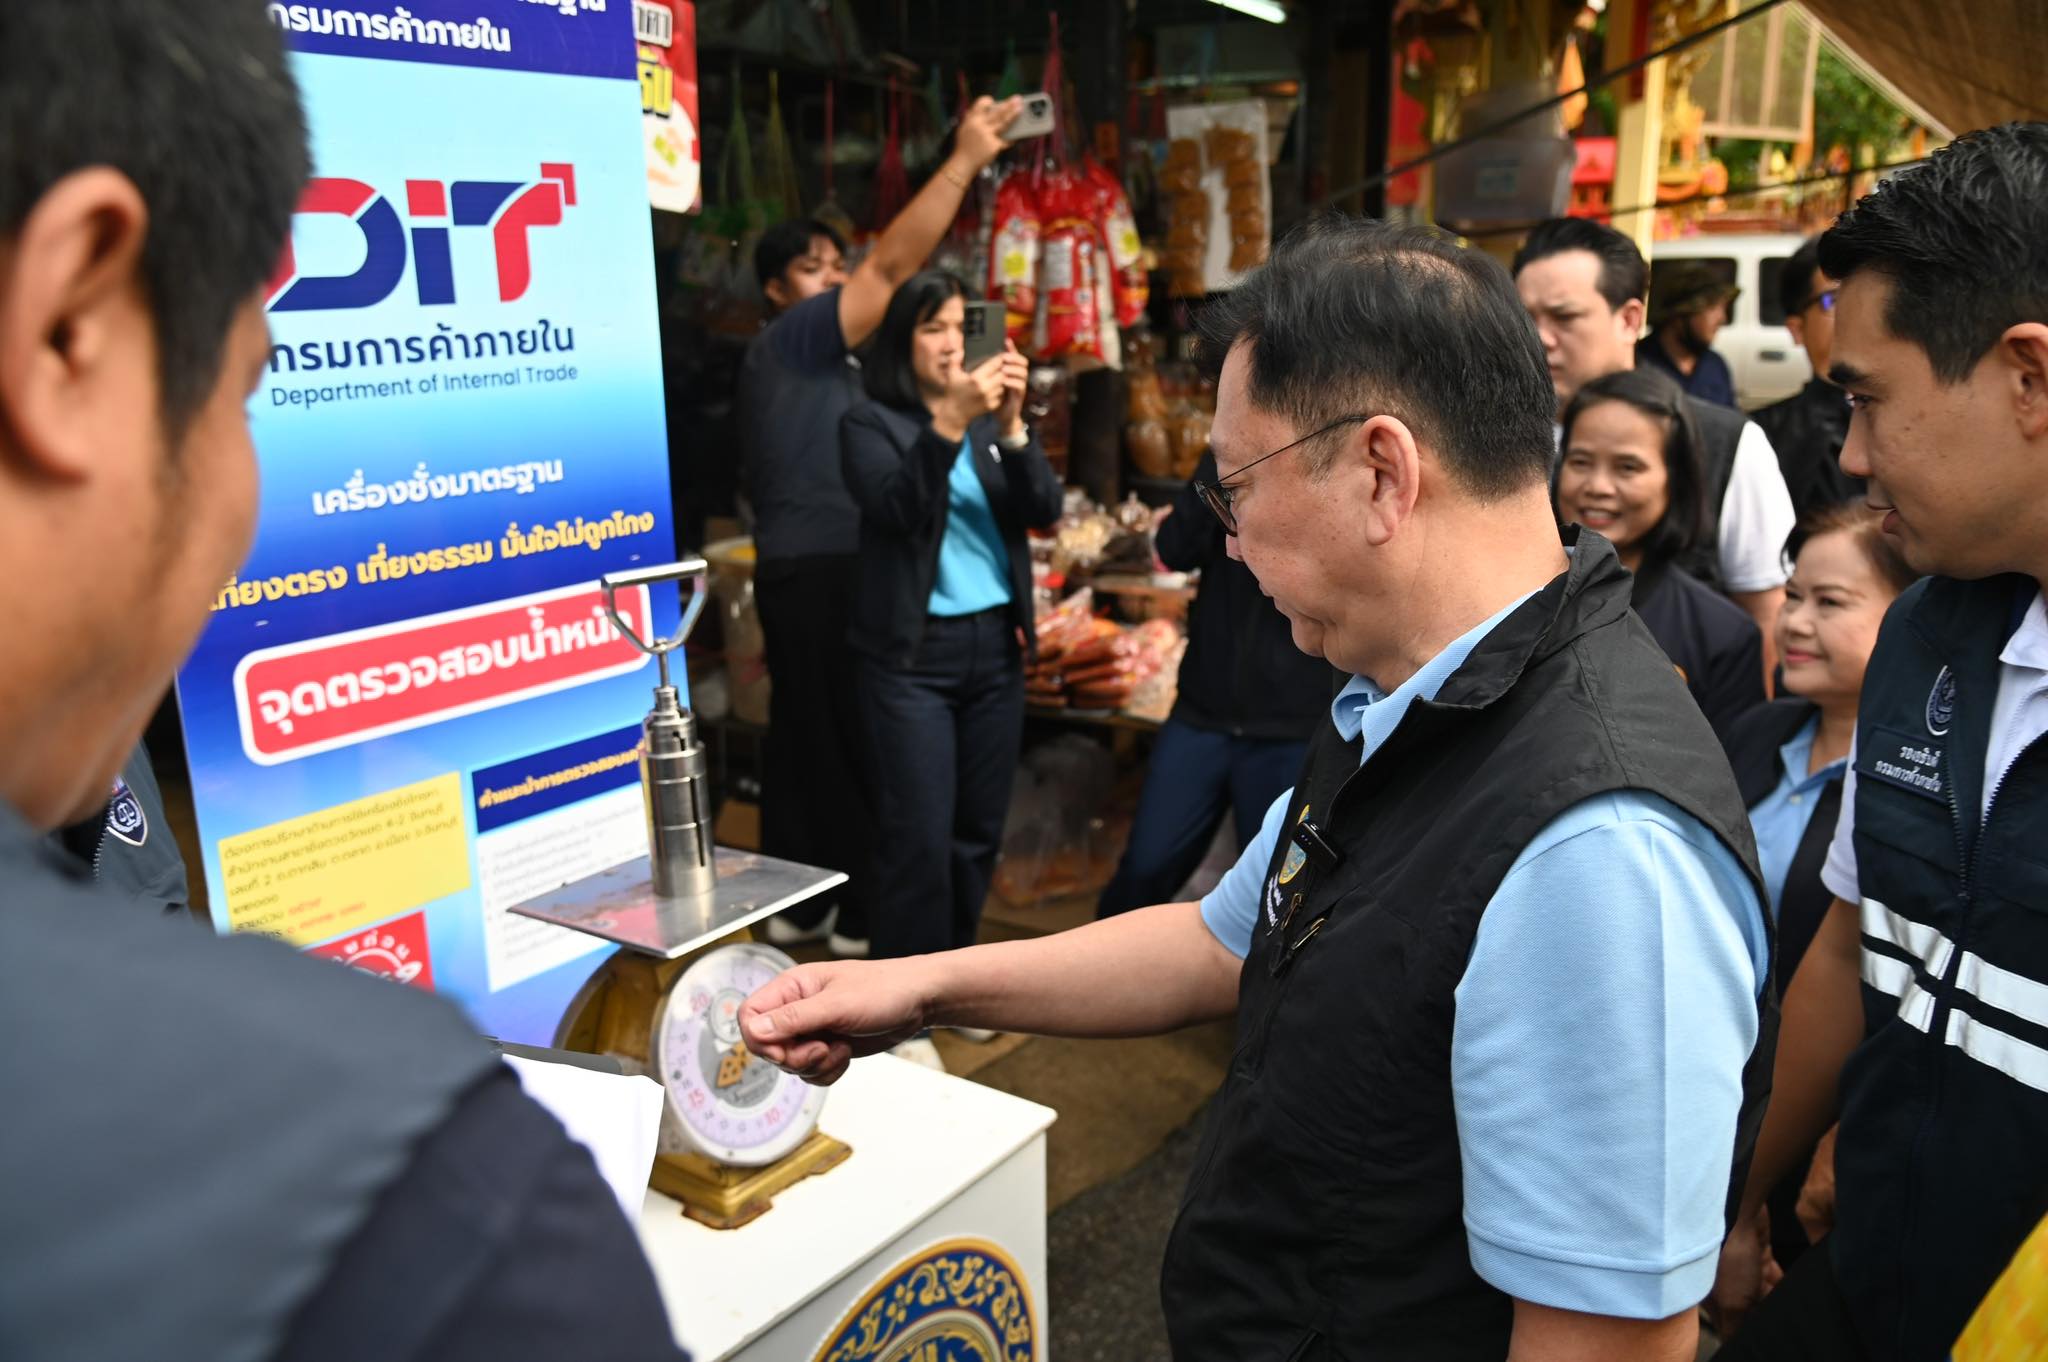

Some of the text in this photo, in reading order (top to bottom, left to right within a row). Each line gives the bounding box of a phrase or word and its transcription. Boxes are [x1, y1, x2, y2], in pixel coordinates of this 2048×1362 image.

[268, 4, 512, 52] กรมการค้าภายใน
[271, 319, 575, 373] กรมการค้าภายใน
[271, 363, 579, 410] Department of Internal Trade
[312, 459, 564, 515] เครื่องชั่งมาตรฐาน
[356, 543, 493, 584] เที่ยงธรรม
[501, 510, 655, 559] มั่นใจไม่ถูกโกง
